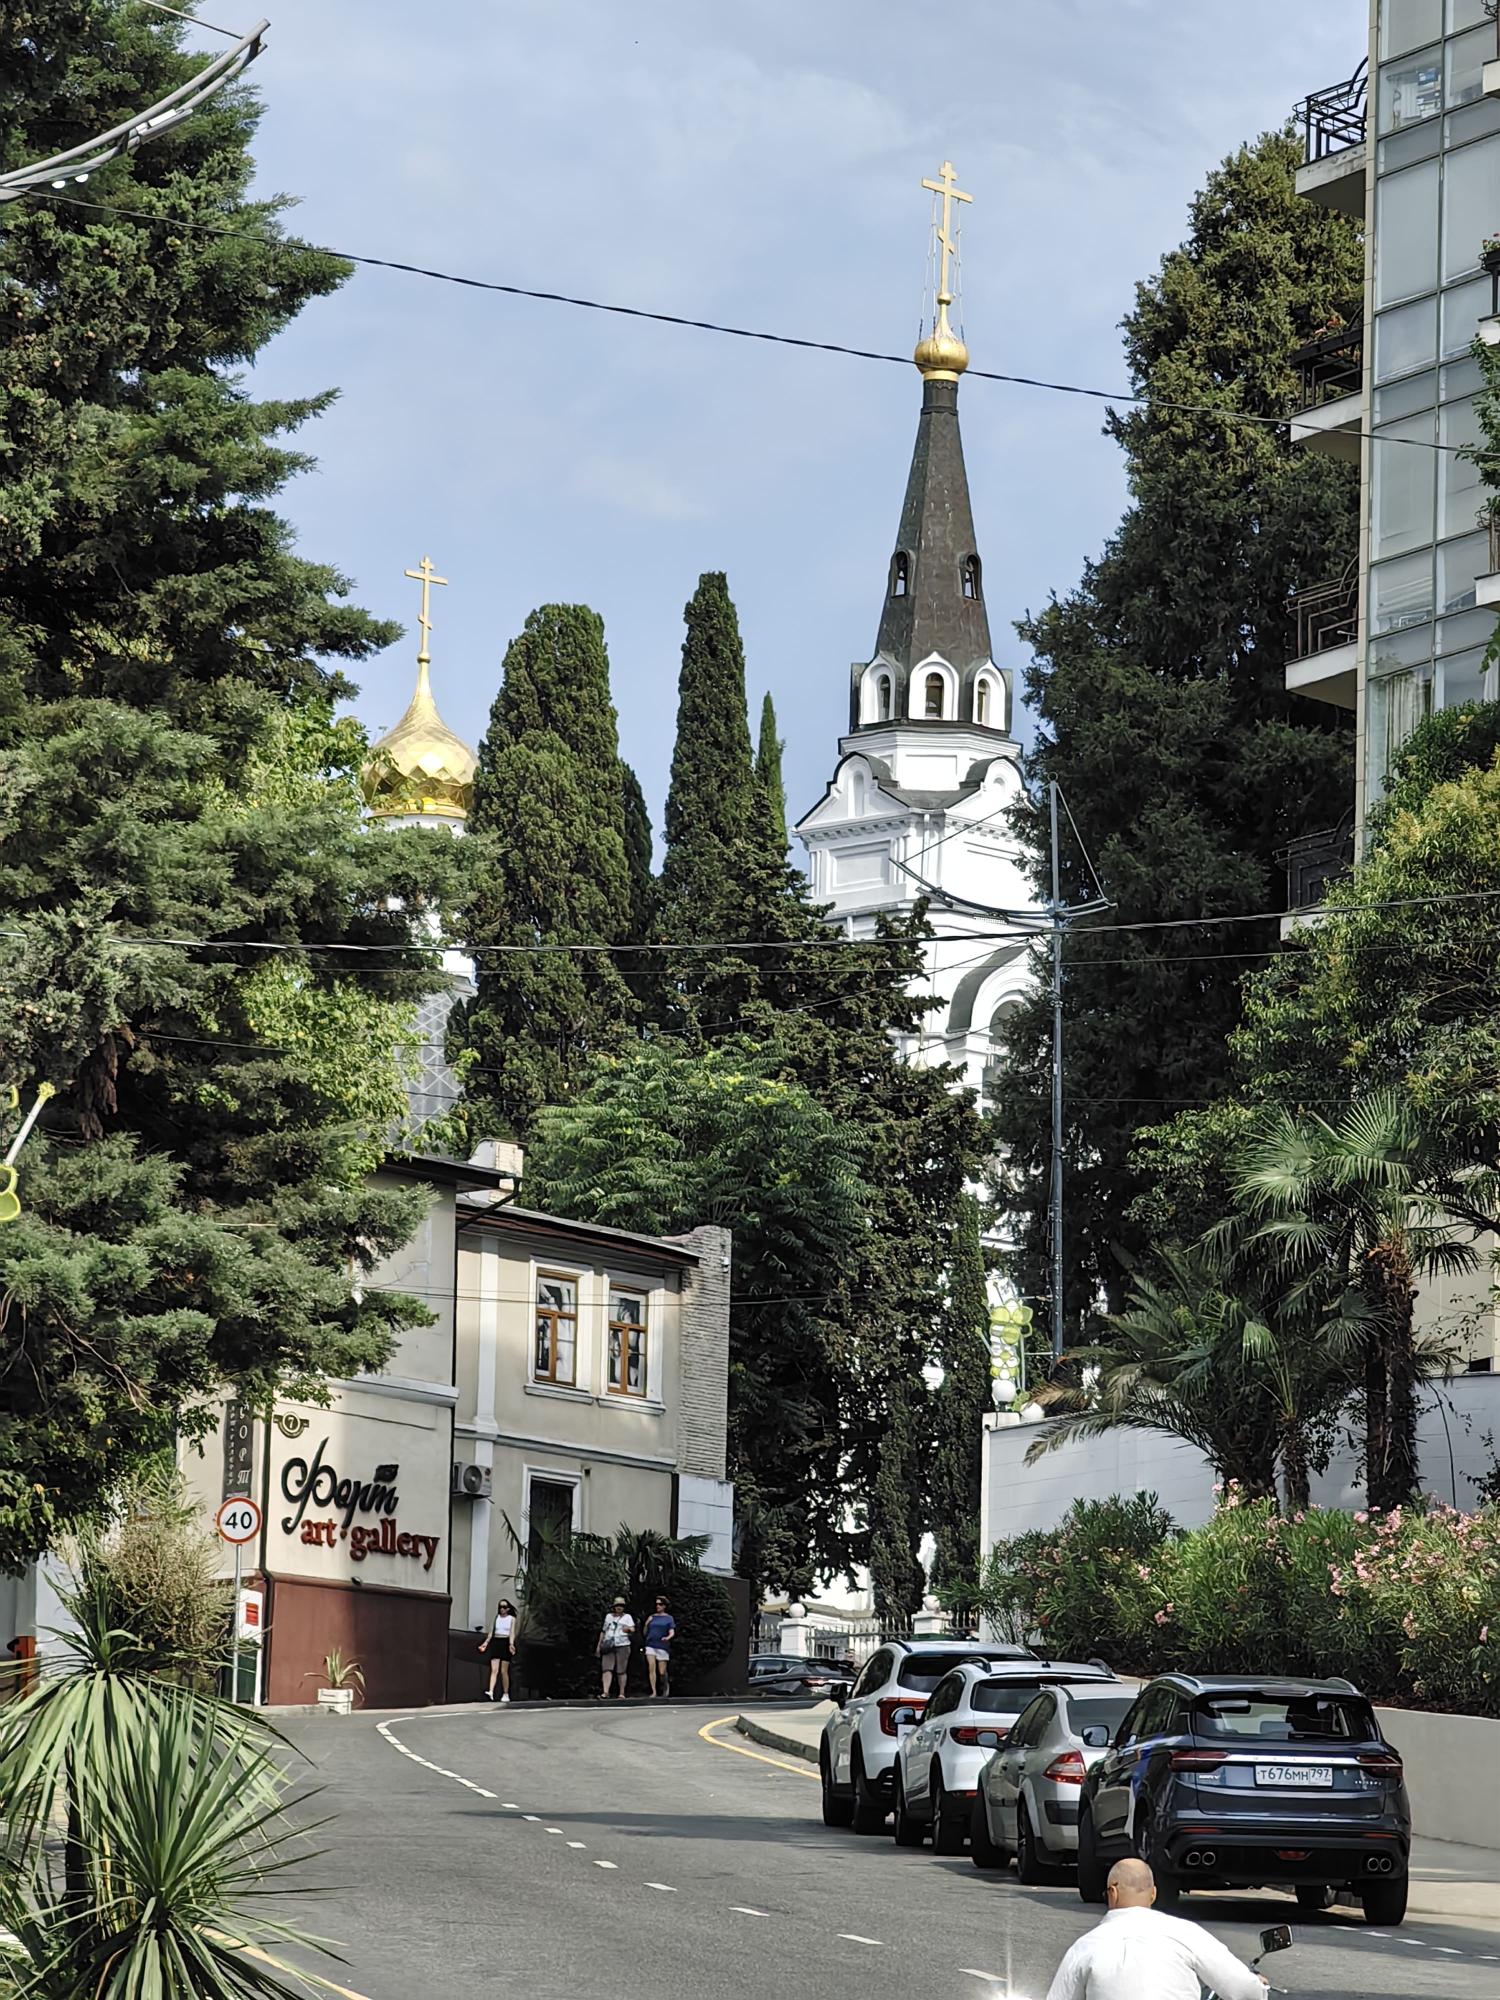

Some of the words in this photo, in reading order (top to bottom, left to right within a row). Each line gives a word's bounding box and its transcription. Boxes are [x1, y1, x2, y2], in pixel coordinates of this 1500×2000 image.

[288, 1416, 295, 1429] 7
[225, 1511, 252, 1529] 40
[300, 1518, 337, 1548] art
[350, 1517, 440, 1571] gallery
